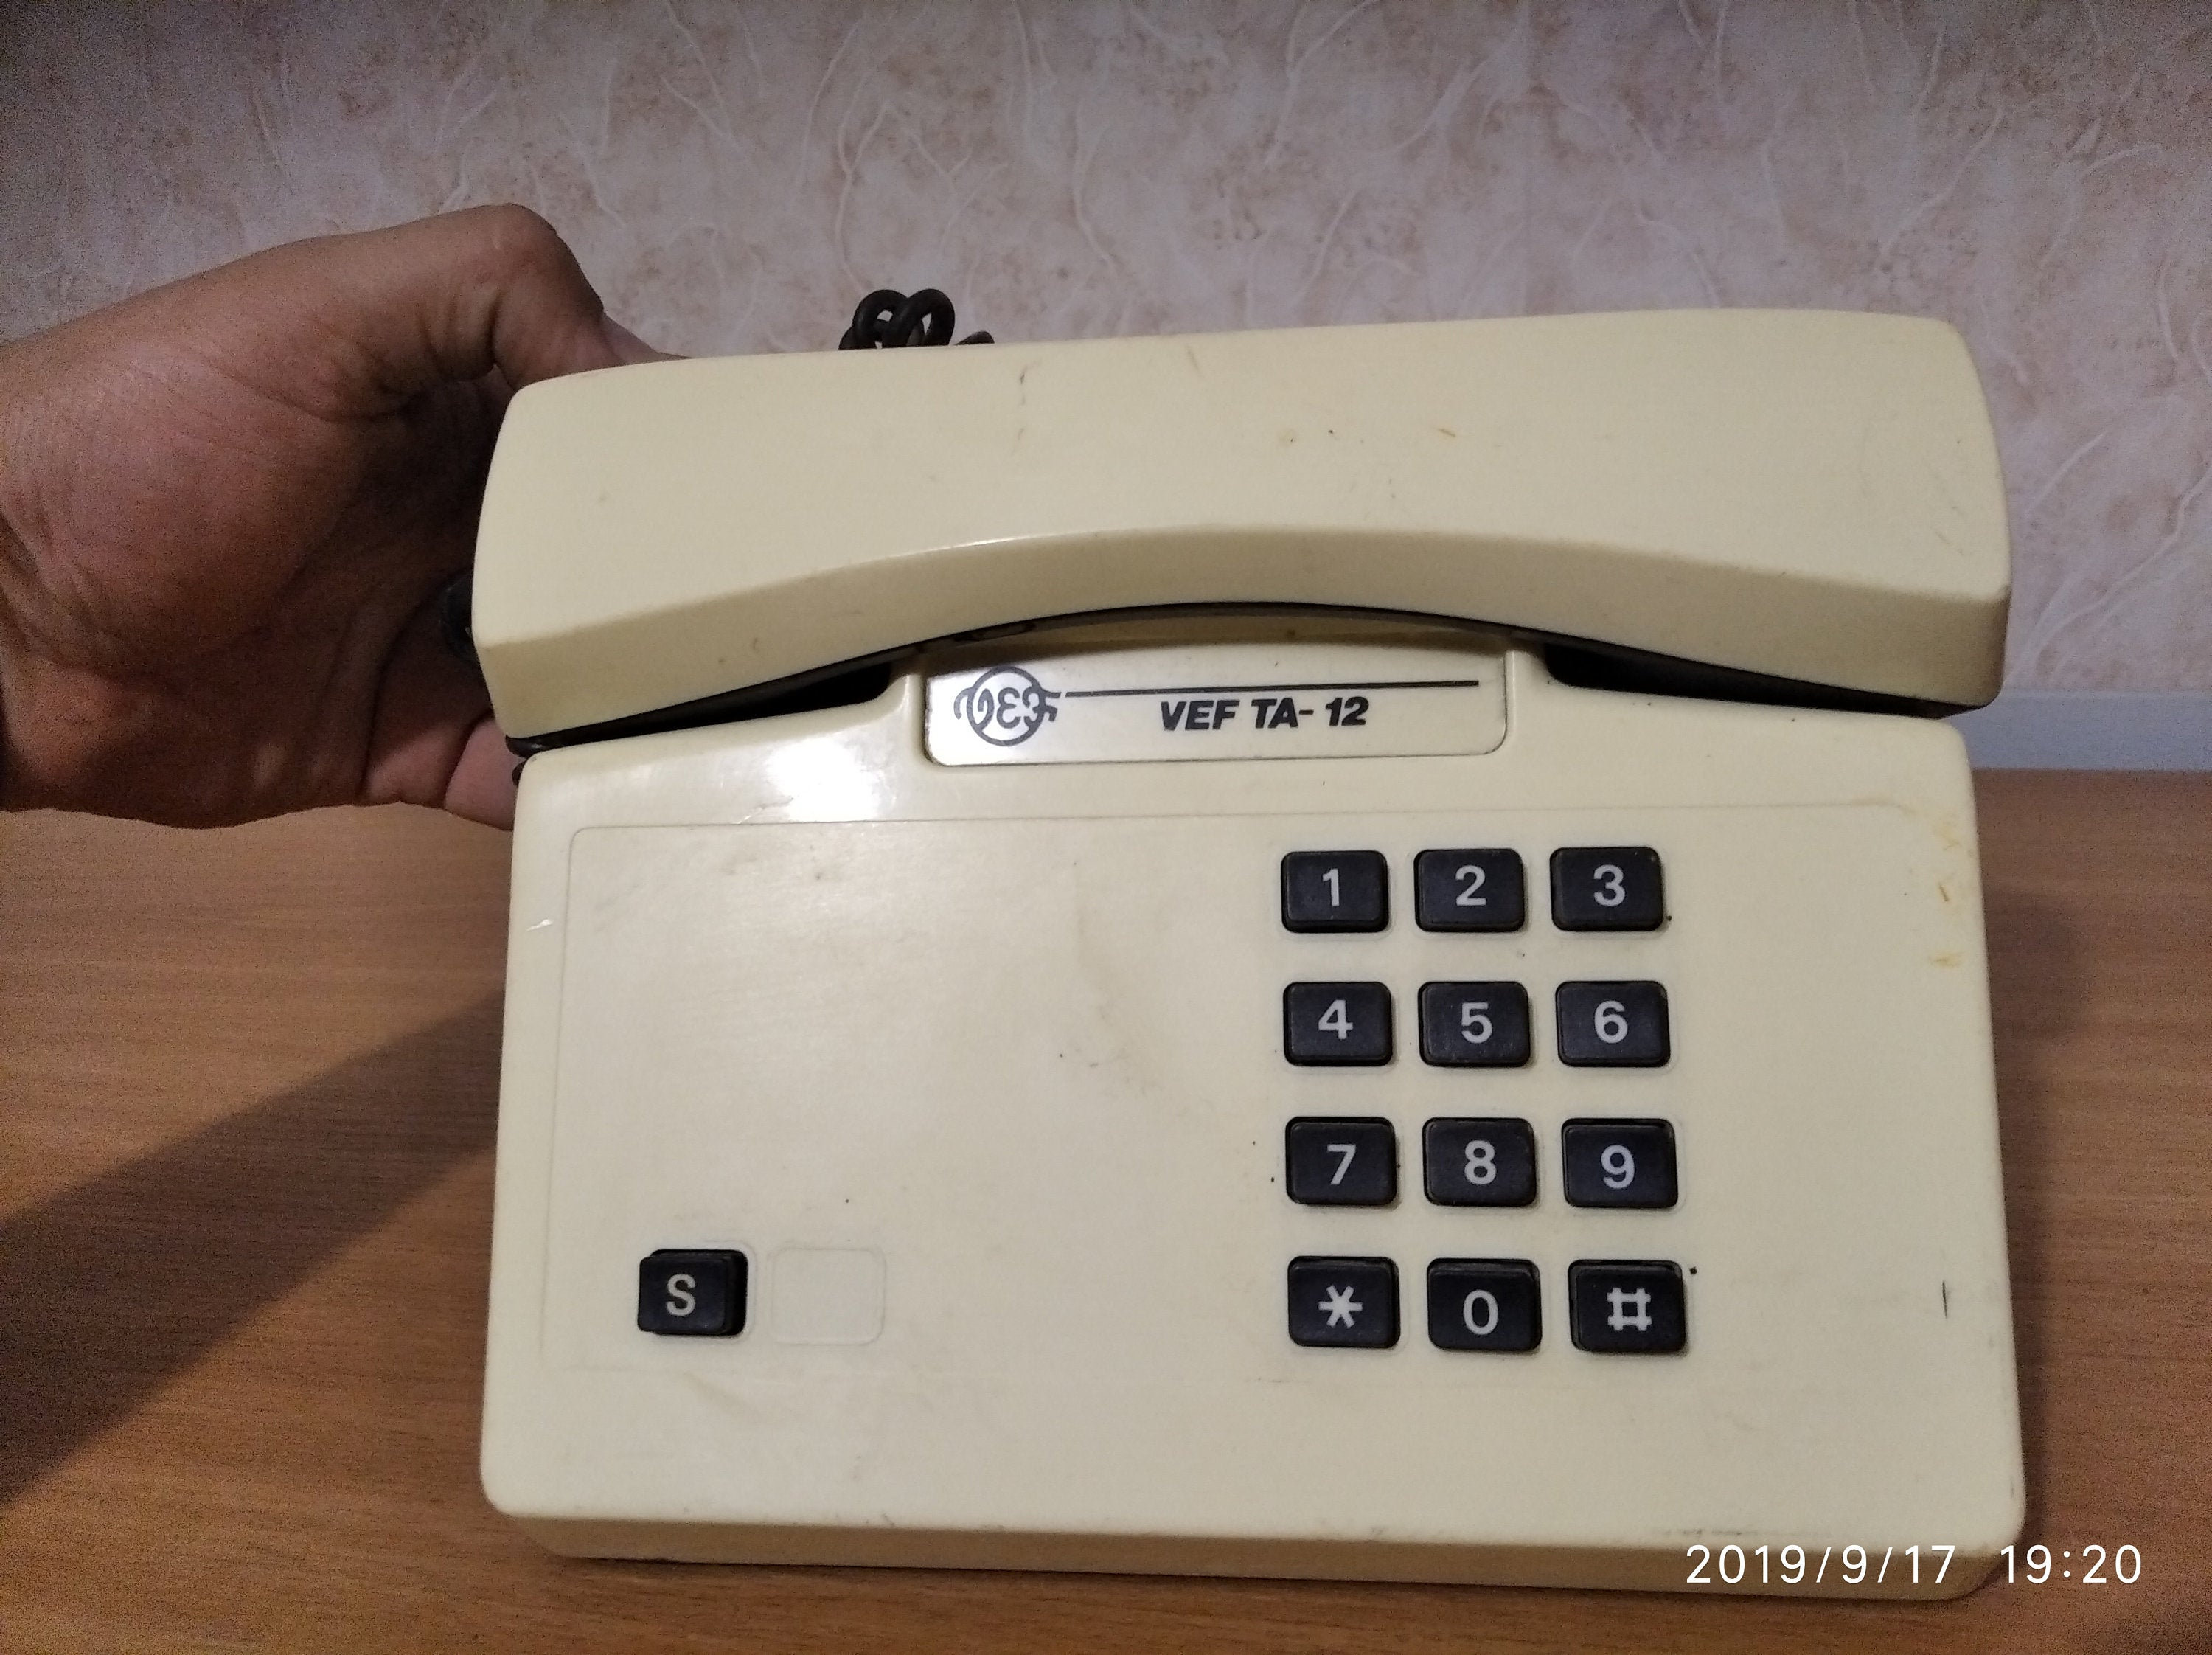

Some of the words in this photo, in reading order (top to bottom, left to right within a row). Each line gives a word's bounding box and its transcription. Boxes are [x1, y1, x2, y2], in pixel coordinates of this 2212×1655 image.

[1161, 699, 1241, 731] VEF
[1322, 869, 1340, 906] 1
[1455, 865, 1486, 906] 2
[1593, 864, 1625, 906] 3
[1318, 999, 1353, 1039] 4
[1461, 1002, 1492, 1044] 5
[1594, 1000, 1628, 1044] 6
[1328, 1144, 1356, 1184] 7
[1464, 1140, 1496, 1185] 8
[1601, 1145, 1635, 1189] 9
[667, 1274, 696, 1316] S
[1464, 1290, 1498, 1335] 0
[1607, 1288, 1652, 1331] #
